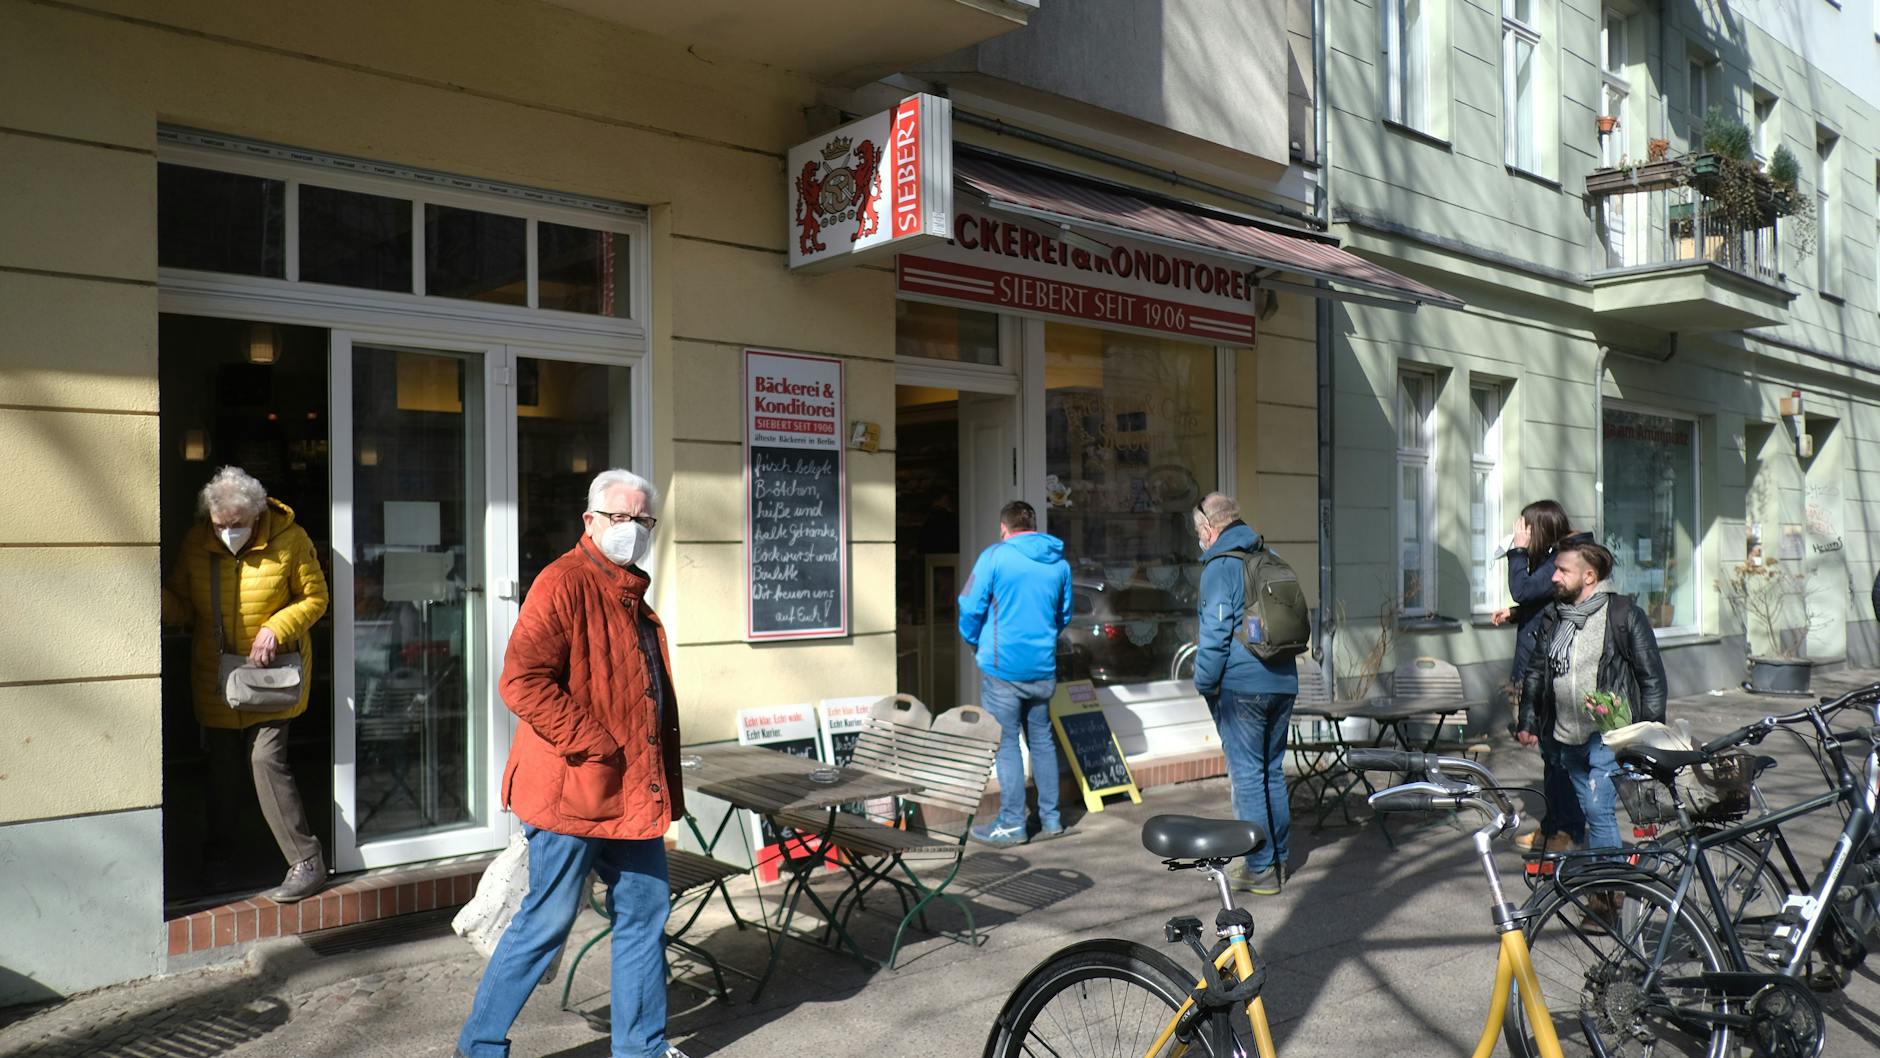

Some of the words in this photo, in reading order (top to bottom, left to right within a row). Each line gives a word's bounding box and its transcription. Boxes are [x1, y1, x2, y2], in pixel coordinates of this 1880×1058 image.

[896, 108, 918, 232] SIEBERT
[947, 213, 1068, 267] CKEREI
[1000, 276, 1088, 314] SIEBERT
[1094, 291, 1137, 322] SEIT
[1142, 302, 1186, 331] 1906
[755, 376, 819, 398] Bäckerei
[822, 383, 834, 399] &
[754, 396, 835, 418] Konditorei
[757, 418, 792, 430] SIEBERT
[793, 420, 811, 432] SEIT
[814, 422, 833, 433] 1906
[754, 453, 792, 478] frisch
[795, 458, 832, 480] belegte
[794, 500, 824, 517] und
[754, 524, 788, 541] kalte
[816, 547, 838, 562] und
[752, 583, 772, 600] Wir
[773, 583, 811, 602] freuen
[813, 589, 835, 599] uns
[775, 606, 796, 624] auf
[746, 729, 761, 741] Echt
